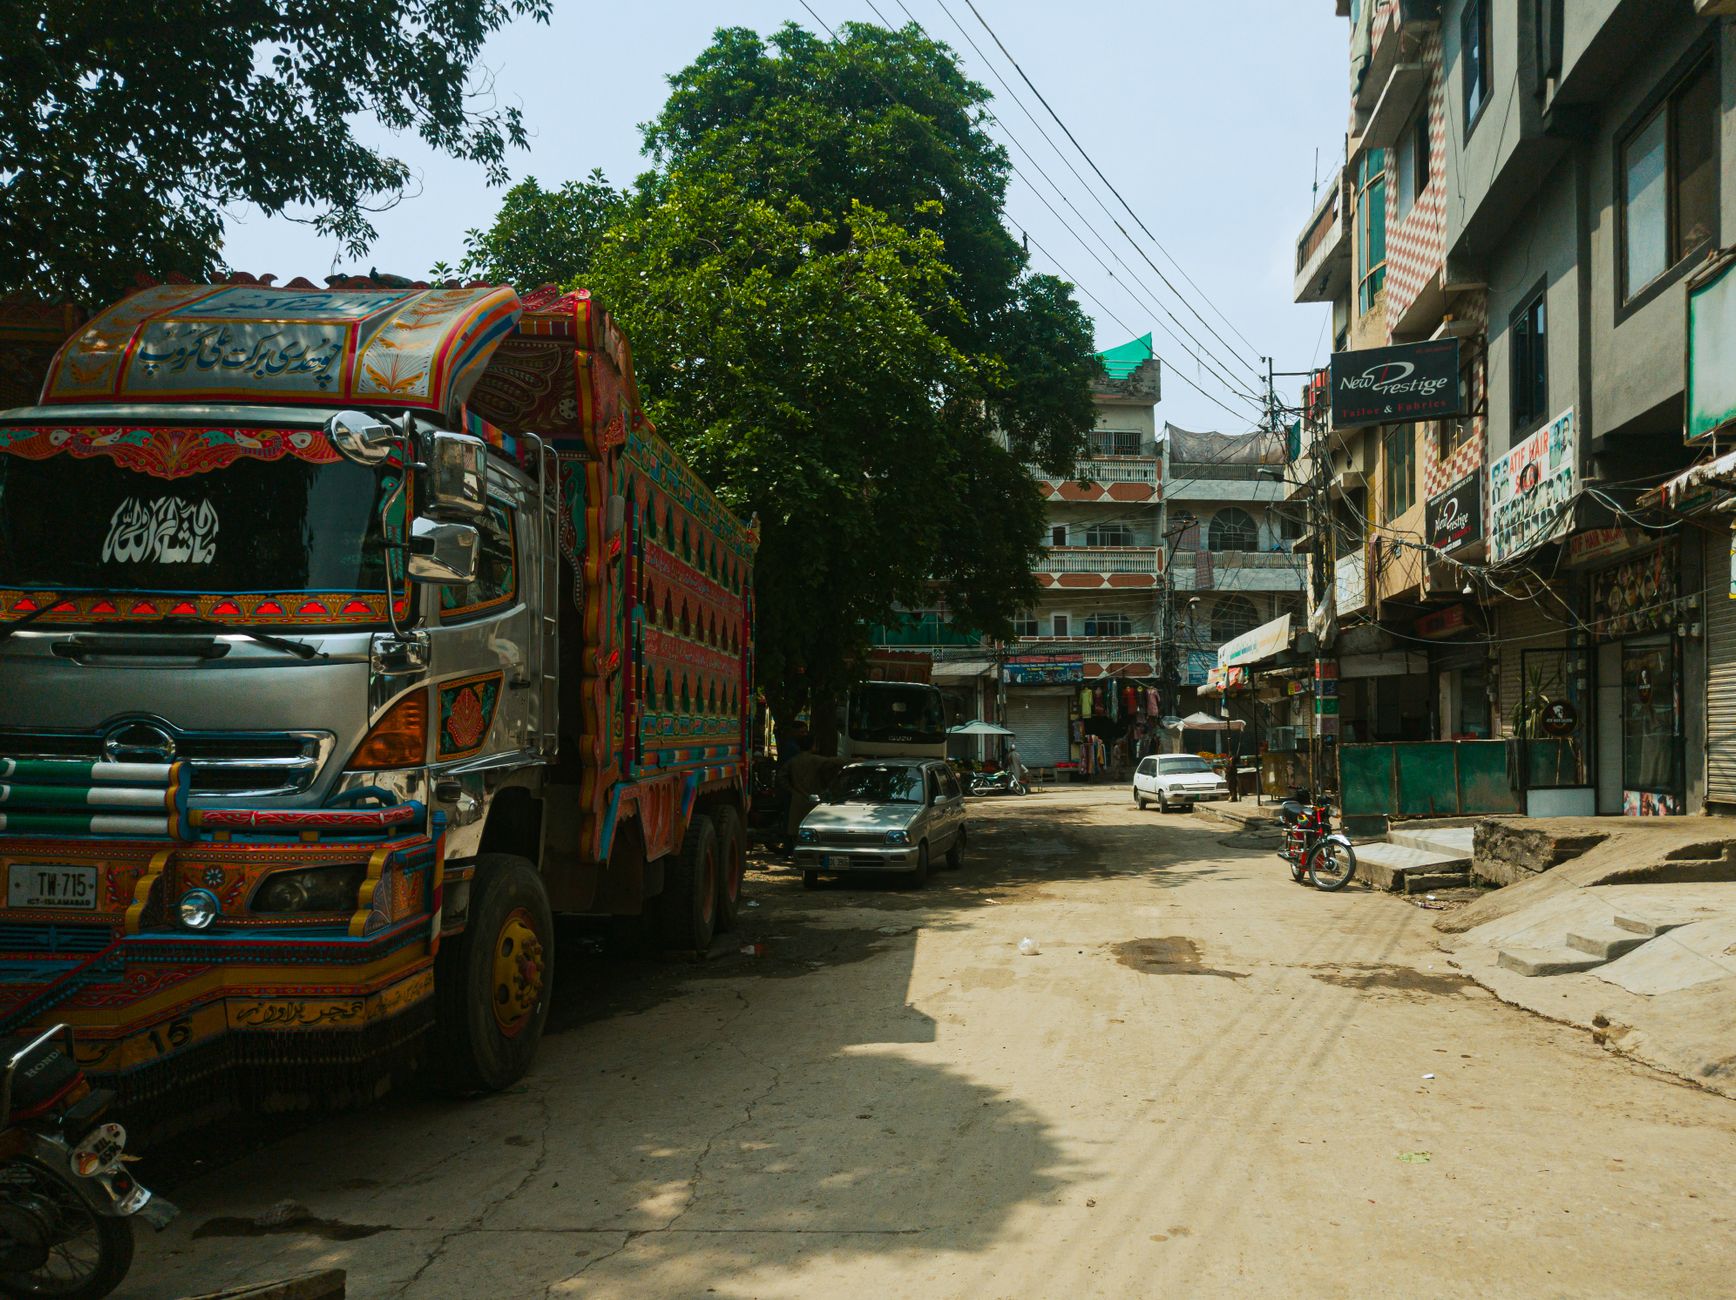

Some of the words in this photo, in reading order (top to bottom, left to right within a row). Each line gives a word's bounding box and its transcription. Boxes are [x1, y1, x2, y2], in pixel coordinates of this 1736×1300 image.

[1340, 375, 1375, 391] New
[1362, 361, 1449, 396] Prestige
[1383, 403, 1394, 414] &
[1509, 447, 1525, 474] ATIF
[1529, 431, 1549, 462] HAIR
[24, 1048, 63, 1078] HOND
